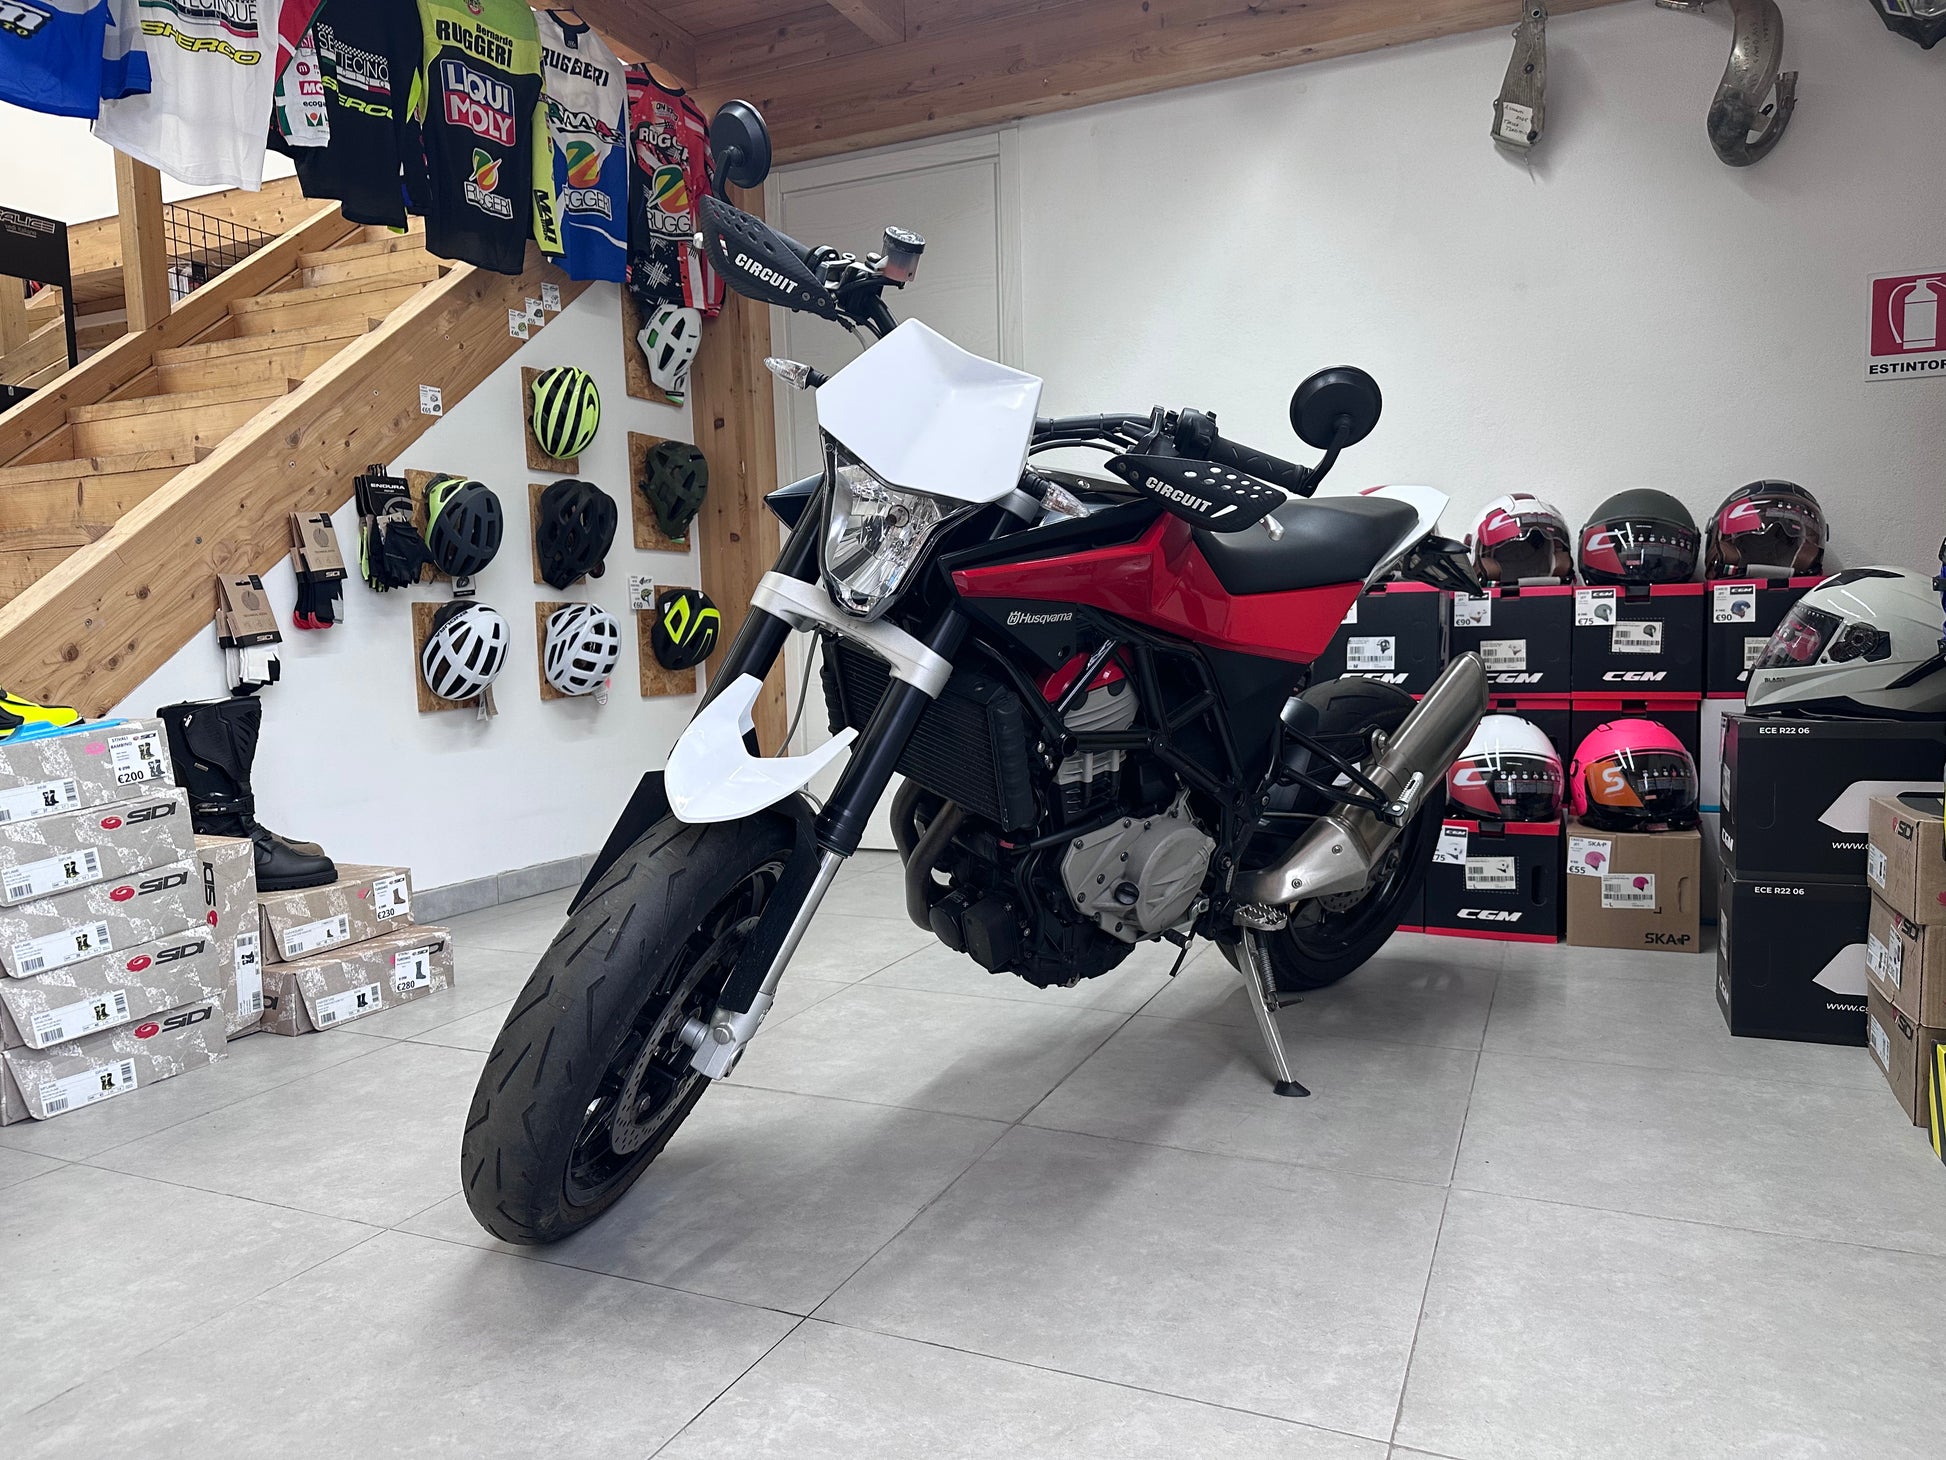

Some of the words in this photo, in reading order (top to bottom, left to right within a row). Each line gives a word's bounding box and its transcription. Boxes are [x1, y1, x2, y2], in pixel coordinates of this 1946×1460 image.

[141, 20, 261, 65] SHERCO
[436, 19, 512, 68] RUGGERI
[476, 23, 513, 47] Bernardo
[541, 46, 610, 87] RUGGERI
[321, 76, 393, 119] SERC
[446, 63, 510, 113] LIQUI
[449, 95, 512, 141] MOLY
[734, 252, 799, 294] CIRCUIT
[1145, 476, 1213, 513] CIRCUIT
[1019, 611, 1073, 624] Husqvarna
[1455, 618, 1471, 626] €90
[1715, 613, 1732, 621] €90
[1602, 671, 1667, 681] CGM
[117, 770, 144, 784] €200
[126, 801, 177, 826] SIDI
[1721, 827, 1734, 851] CGM
[1569, 865, 1586, 874] €55
[138, 871, 188, 896] SIDI
[203, 861, 217, 907] SIDI
[1754, 886, 1772, 894] ECE
[1774, 887, 1791, 895] R22
[1792, 888, 1805, 896] 06
[377, 907, 395, 920] €230
[1457, 908, 1522, 922] CGM
[155, 940, 205, 966] SIDI
[396, 980, 415, 992] €280
[162, 1006, 213, 1033] SIDI
